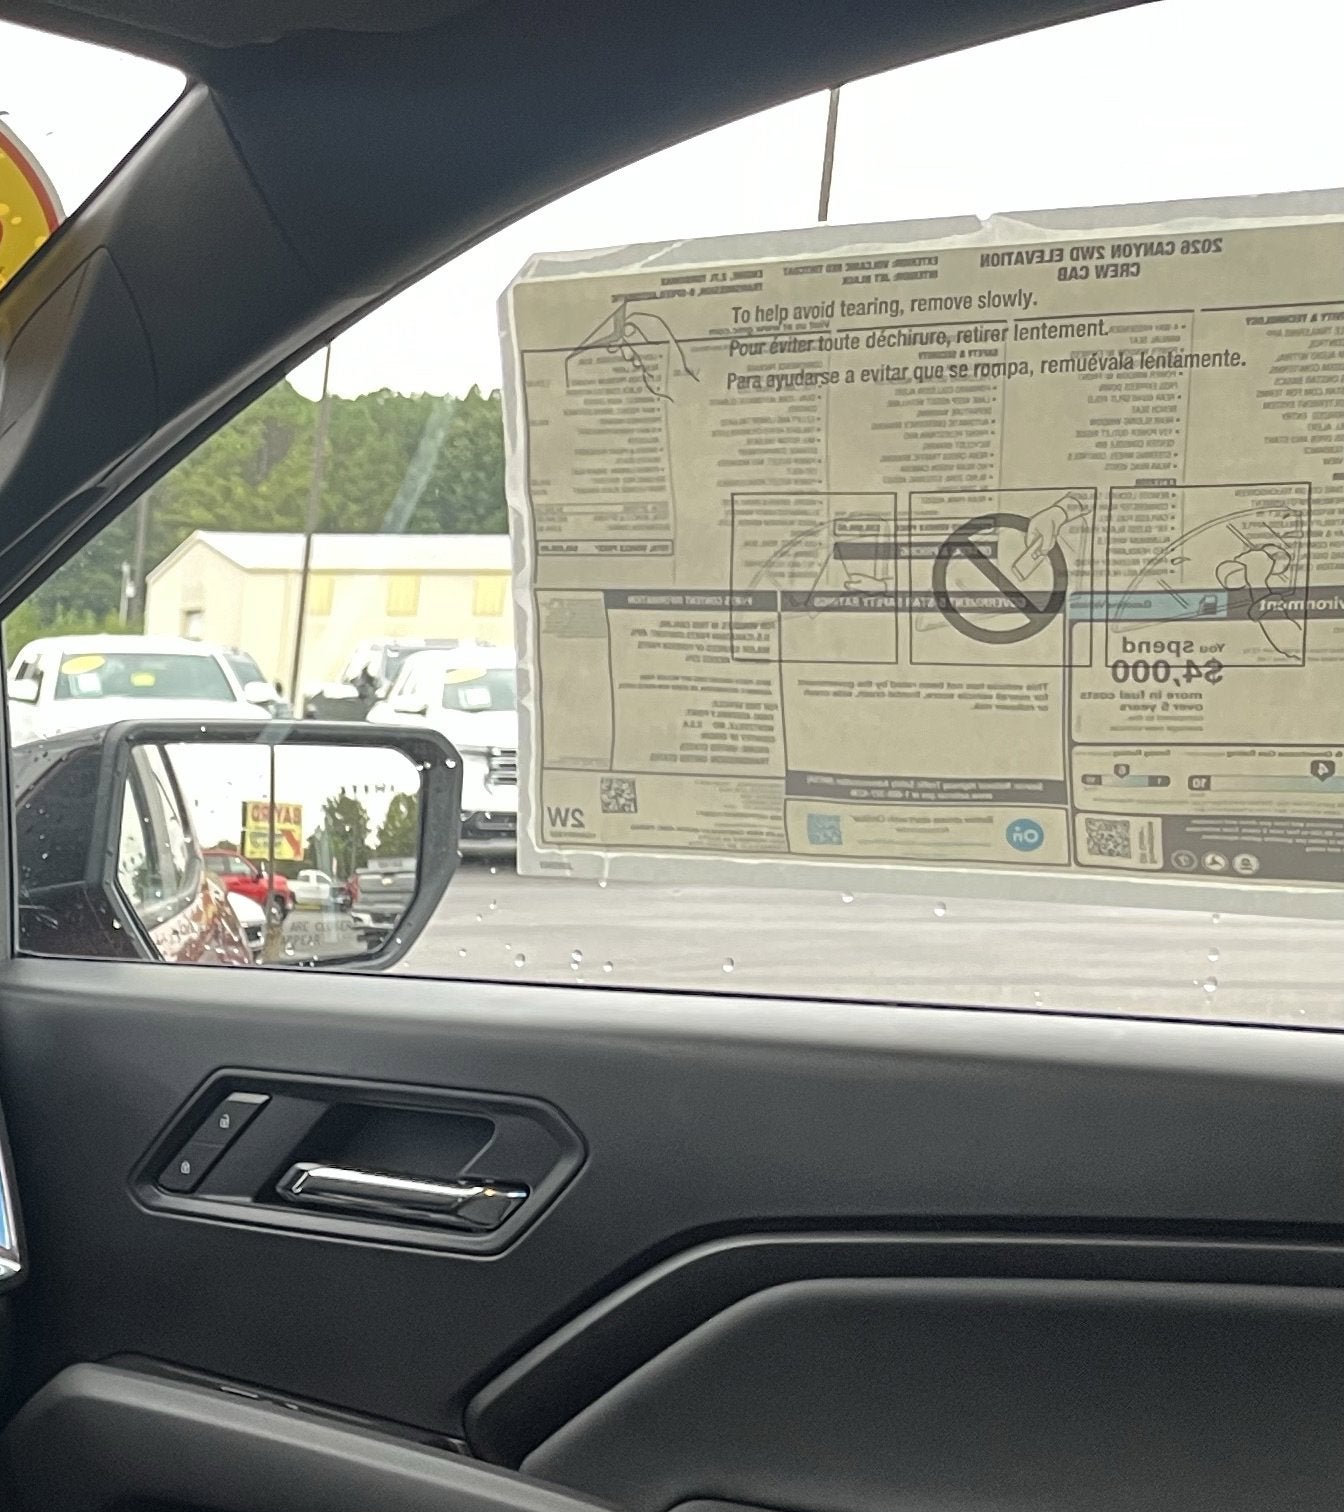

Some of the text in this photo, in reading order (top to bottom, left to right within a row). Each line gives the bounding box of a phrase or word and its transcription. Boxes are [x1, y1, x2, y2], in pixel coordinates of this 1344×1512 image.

[732, 289, 1038, 326] To help avoid tearing, remove slowly.
[729, 319, 1109, 358] Pour éviter toute déchirure, retirer lentement.
[727, 348, 1247, 391] Para ayudarse a evitar que se rompa, remuévala lentamente.
